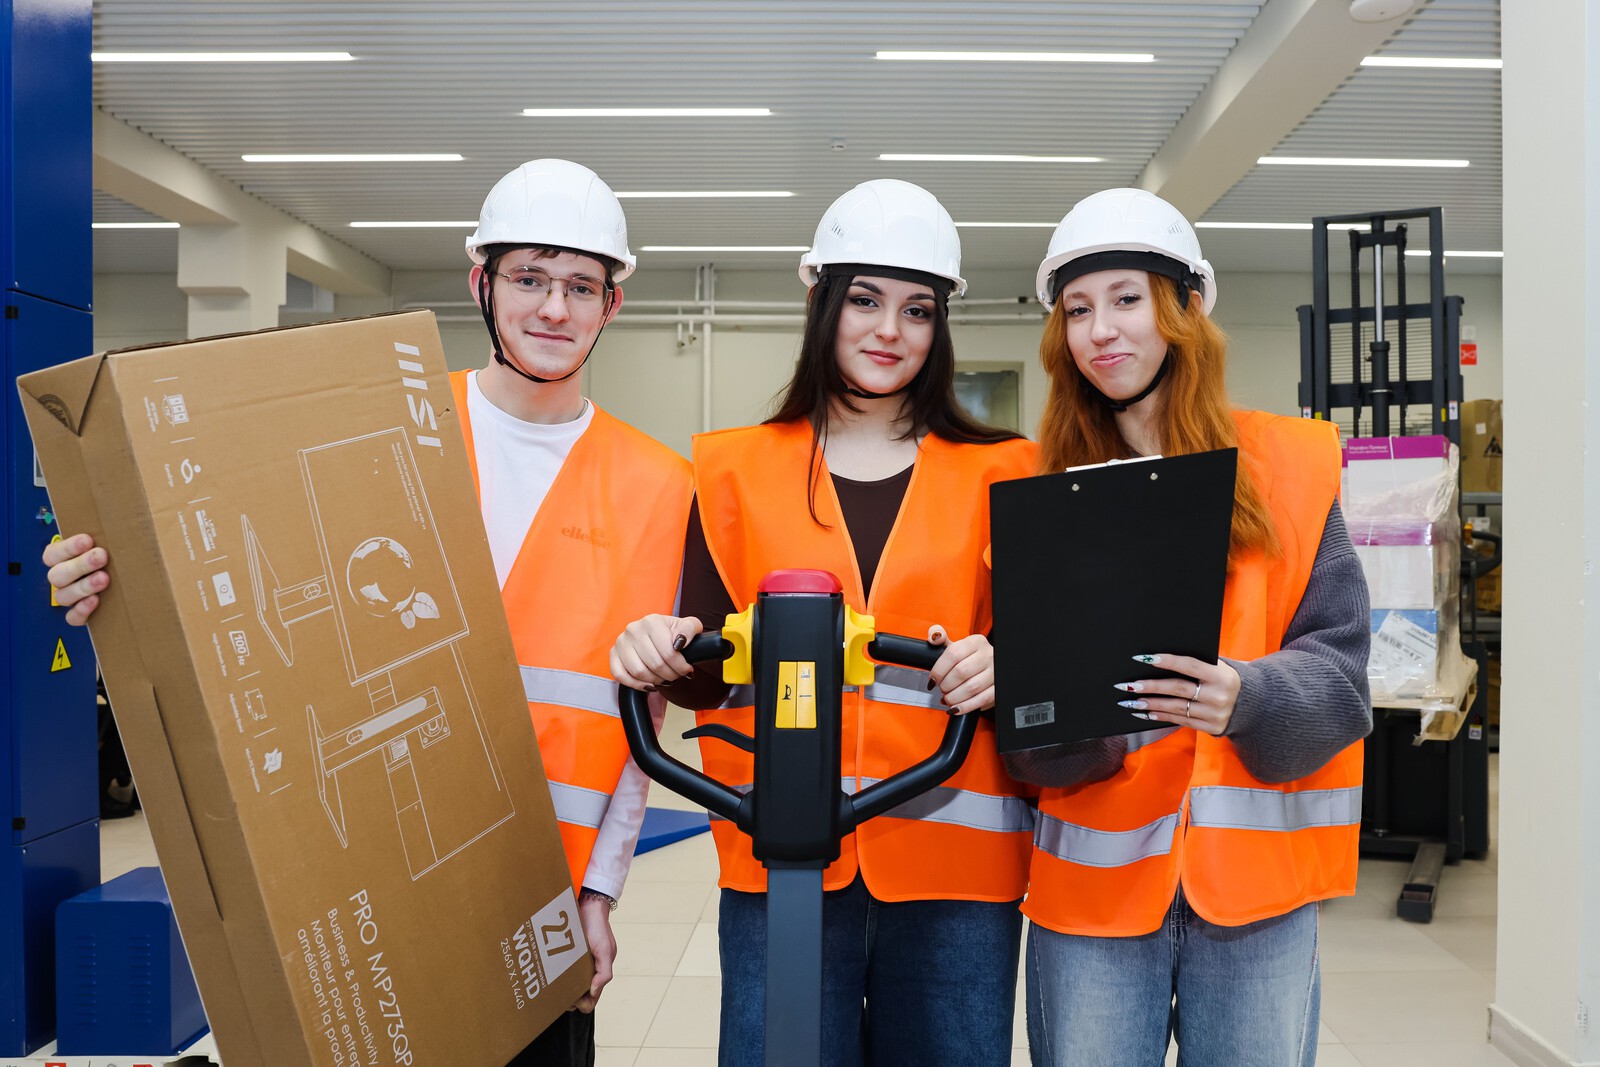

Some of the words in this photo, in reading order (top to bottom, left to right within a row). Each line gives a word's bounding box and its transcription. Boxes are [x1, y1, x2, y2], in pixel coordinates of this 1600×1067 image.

[394, 342, 442, 448] MSI
[234, 634, 246, 654] 100
[311, 920, 336, 984] Moniteur
[329, 987, 347, 1020] pour
[327, 908, 350, 967] Business
[512, 924, 540, 999] WQHD
[541, 910, 576, 957] 27
[298, 929, 328, 1008] améliorant
[322, 1009, 332, 1025] la
[345, 969, 355, 982] &
[349, 889, 378, 945] PRO
[368, 952, 413, 1066] MP273QP
[500, 938, 514, 969] 2560
[511, 980, 525, 1010] 1440
[349, 983, 378, 1065] Productivity
